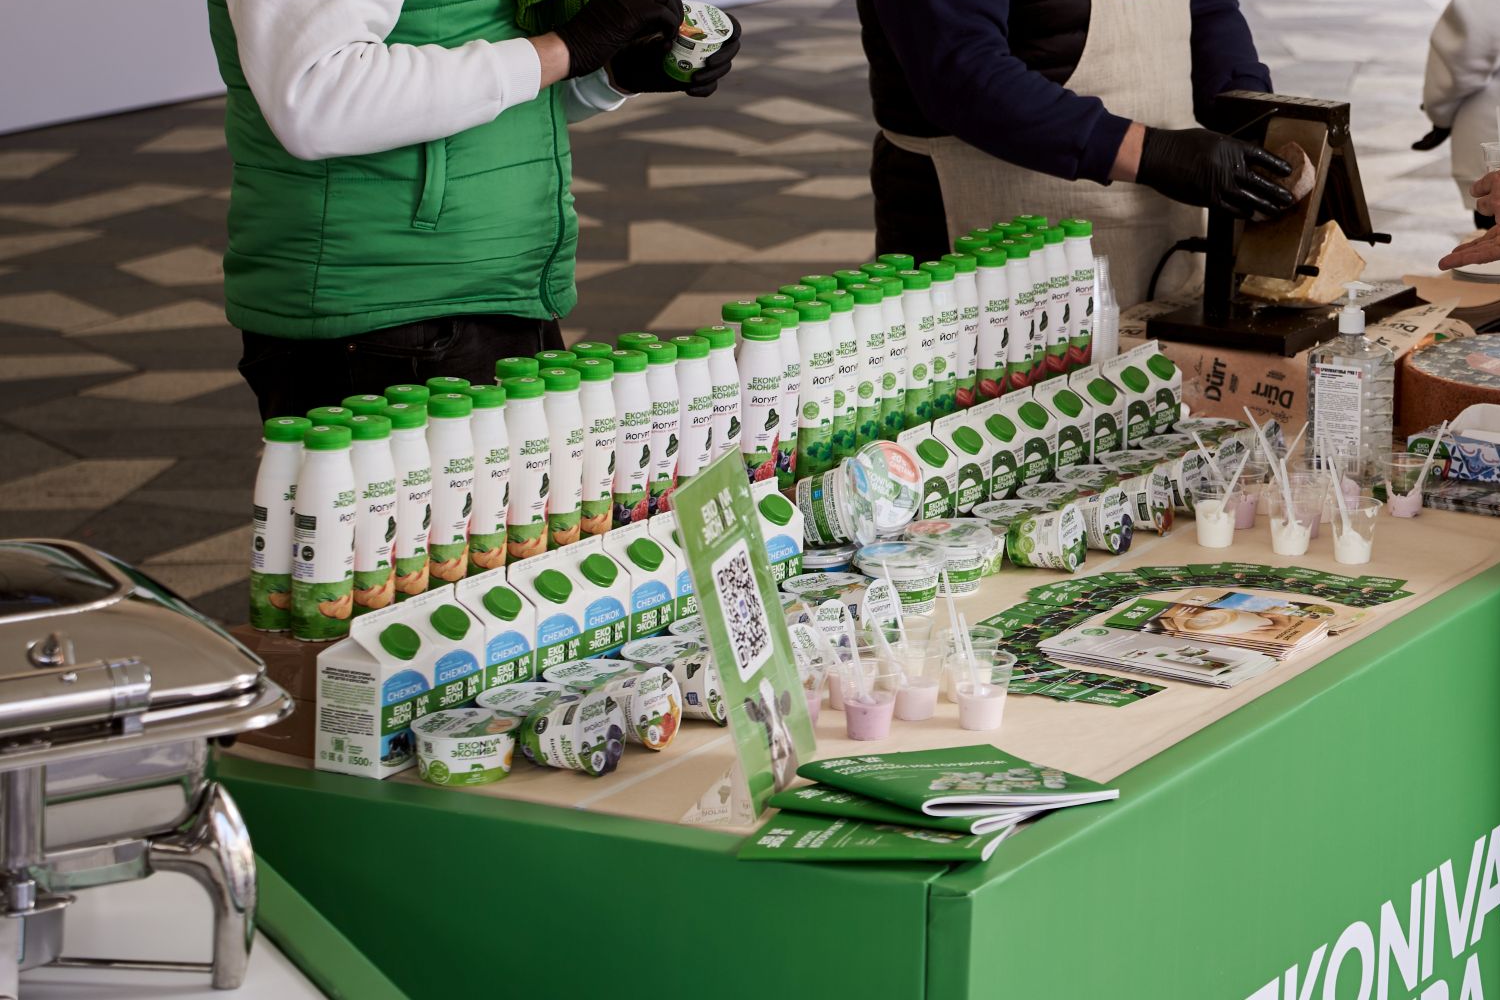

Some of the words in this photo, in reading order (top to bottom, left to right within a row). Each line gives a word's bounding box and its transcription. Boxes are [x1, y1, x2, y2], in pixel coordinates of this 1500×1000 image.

[1204, 357, 1226, 402] Dürr
[752, 395, 778, 404] ЙОГУРТ
[1251, 382, 1294, 409] Dürr
[713, 403, 738, 413] ЙОГУРТ
[636, 592, 666, 609] СНЕЖОК
[589, 609, 620, 626] СНЕЖОК
[542, 627, 574, 644] СНЕЖОК
[491, 645, 524, 662] СНЕЖОК
[439, 664, 473, 681] СНЕЖОК
[387, 684, 423, 702] СНЕЖОК
[450, 744, 498, 758] ЭКОНИВА
[457, 738, 501, 751] EKONIVA
